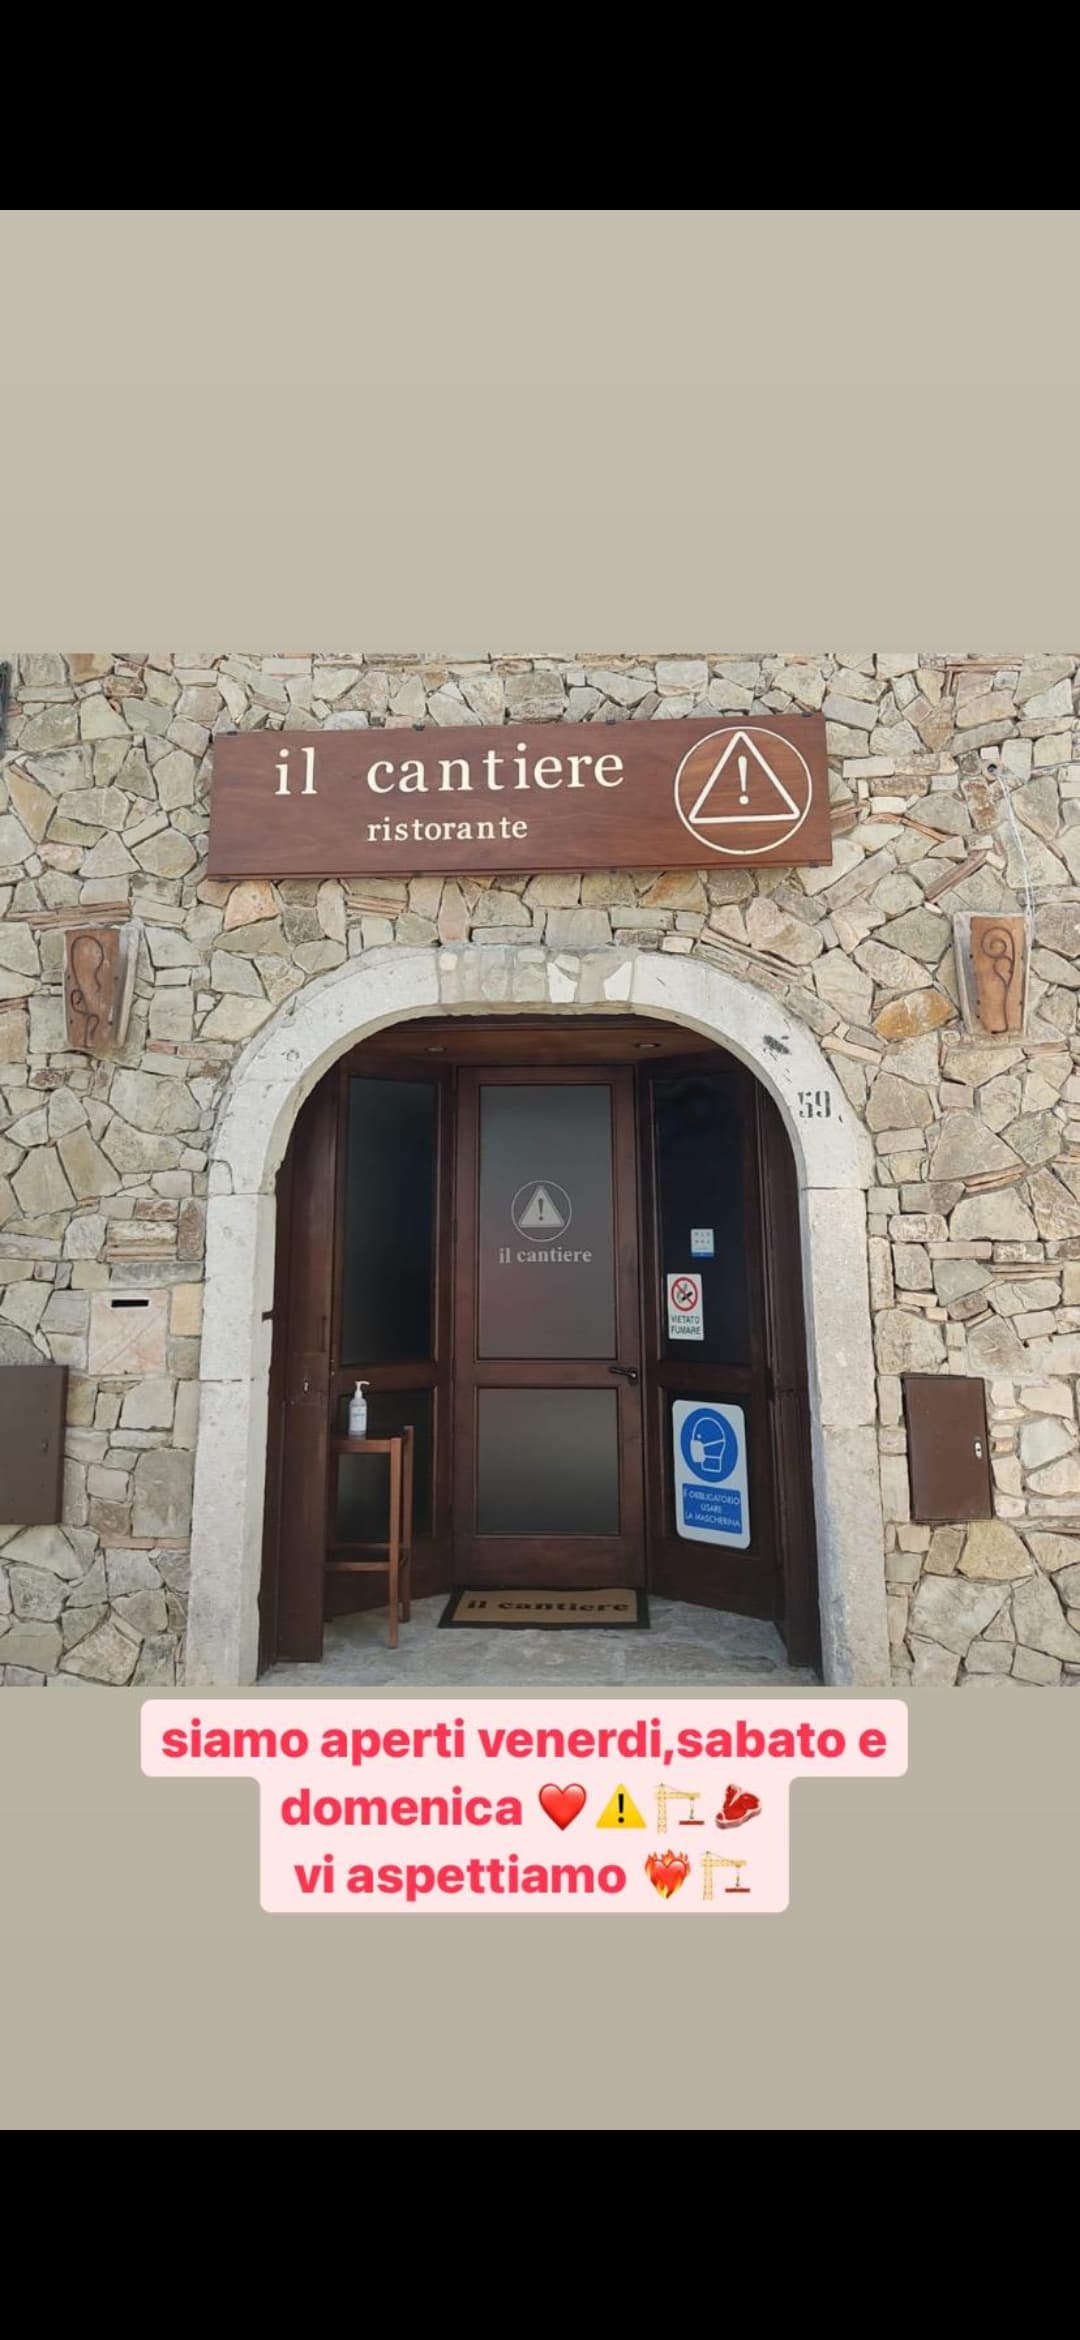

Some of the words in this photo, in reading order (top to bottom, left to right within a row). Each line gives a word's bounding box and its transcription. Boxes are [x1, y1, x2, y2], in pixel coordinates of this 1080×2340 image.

[275, 747, 318, 796] il
[366, 742, 625, 794] cantiere
[367, 816, 528, 842] ristorante
[798, 1090, 831, 1118] 59
[499, 1247, 511, 1264] il
[516, 1246, 593, 1263] cantiere
[671, 1315, 700, 1324] VIETATO
[671, 1326, 701, 1335] FUMARE
[467, 1600, 487, 1609] il
[497, 1600, 629, 1612] cantiere
